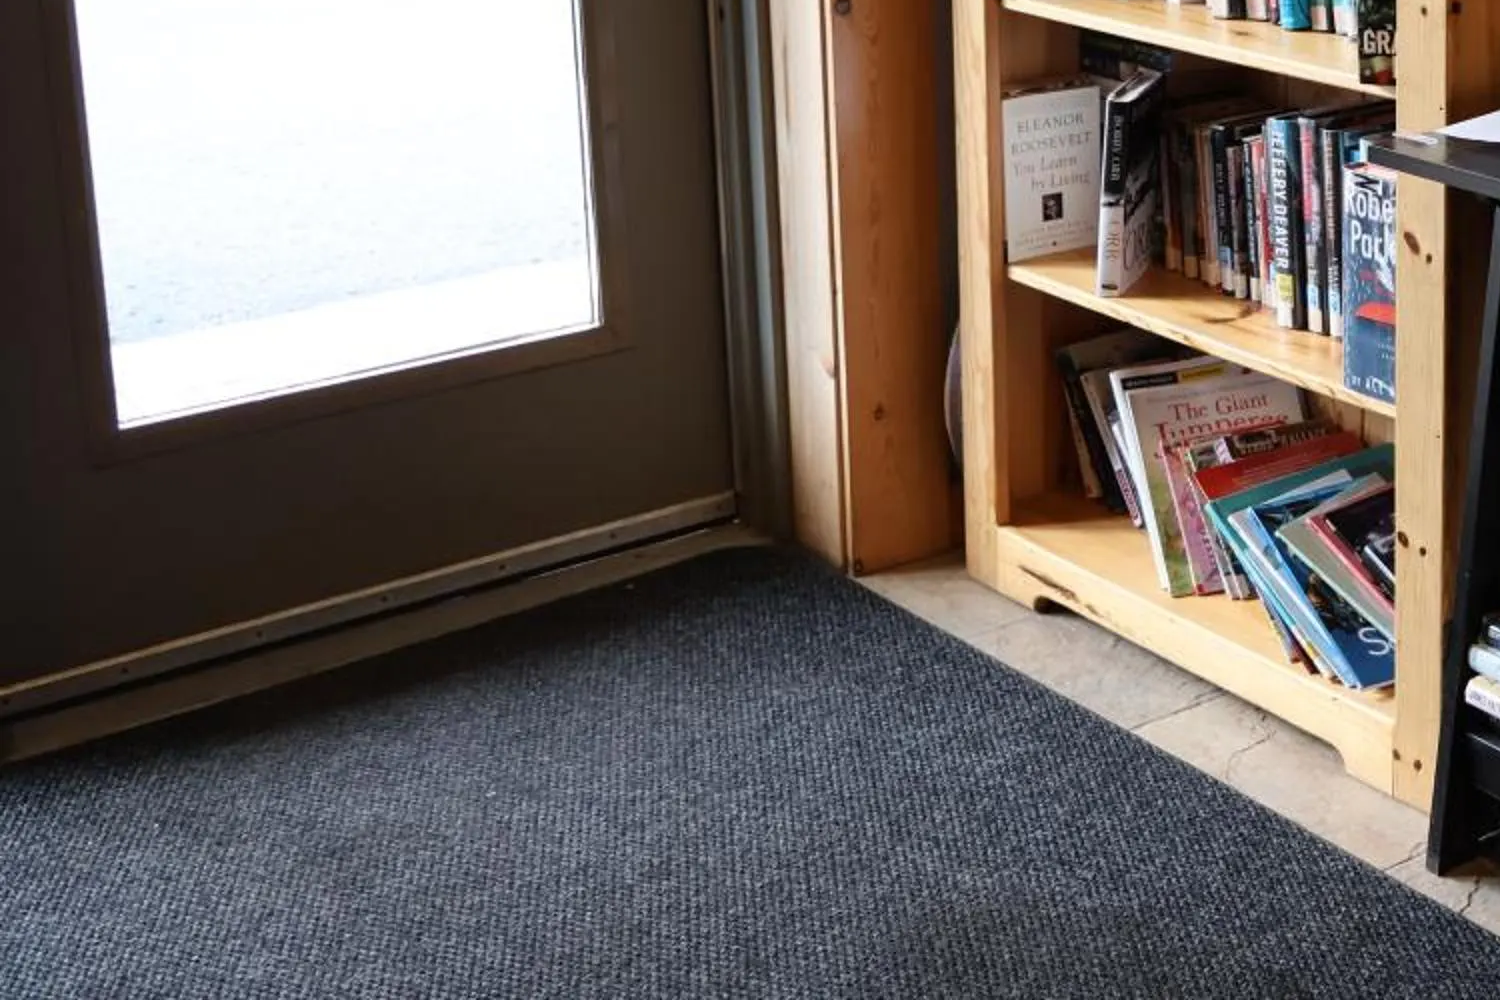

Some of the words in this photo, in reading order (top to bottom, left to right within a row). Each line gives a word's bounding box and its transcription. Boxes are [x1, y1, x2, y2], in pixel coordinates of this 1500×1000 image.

[1017, 112, 1085, 134] ELEANOR
[1112, 115, 1124, 152] BOBBY
[1010, 131, 1092, 156] ROOSEVELT
[1012, 161, 1036, 177] You
[1040, 155, 1078, 172] Learn
[1110, 156, 1122, 181] ORR
[1271, 131, 1288, 199] JEFFERY
[1050, 172, 1092, 189] Living
[1275, 203, 1291, 269] DEAVER
[1169, 404, 1209, 423] The
[1215, 394, 1269, 415] Giant
